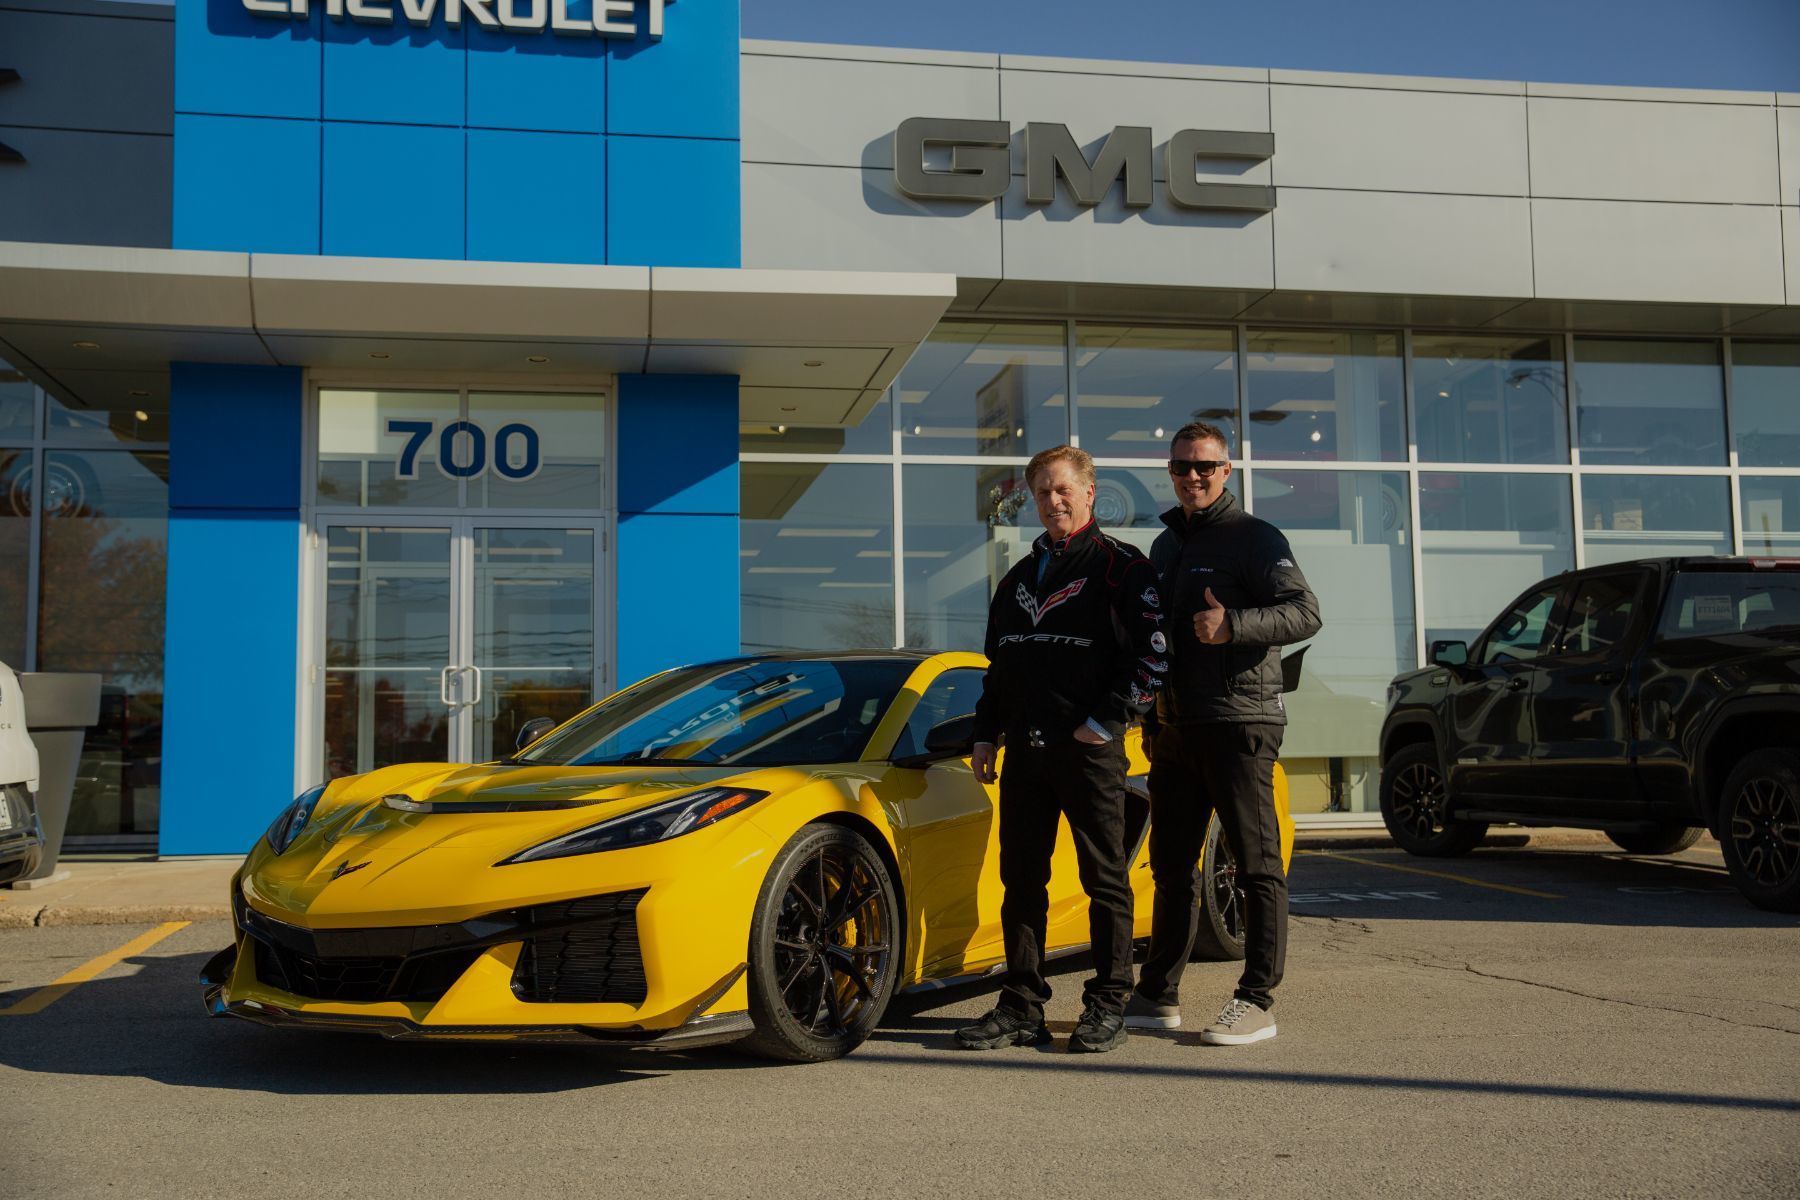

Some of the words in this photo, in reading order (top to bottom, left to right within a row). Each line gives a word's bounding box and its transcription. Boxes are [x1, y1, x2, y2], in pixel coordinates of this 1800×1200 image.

[242, 0, 666, 38] ROLET
[895, 118, 1275, 210] GMC
[385, 417, 543, 481] 700
[999, 634, 1094, 647] ORVETTE
